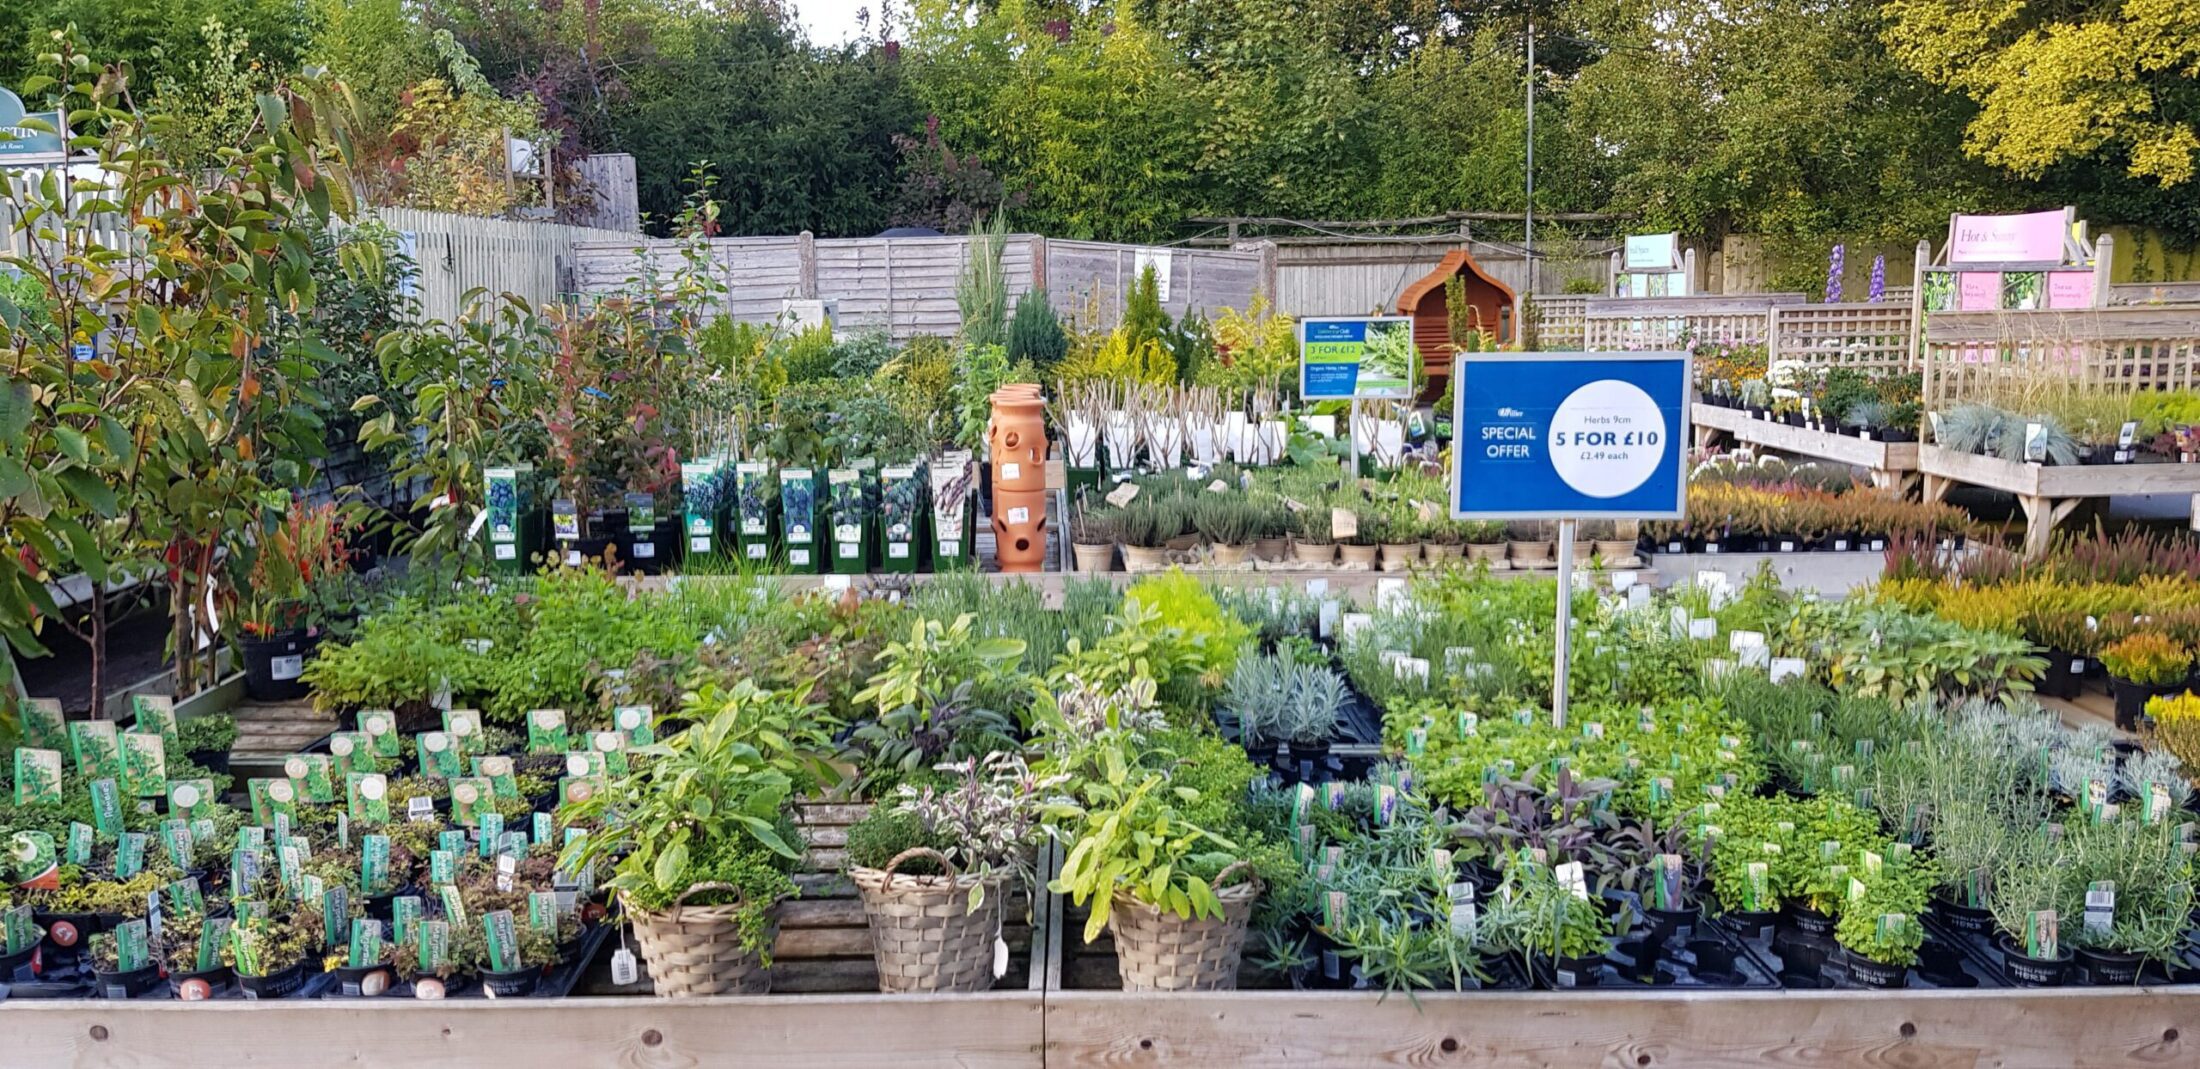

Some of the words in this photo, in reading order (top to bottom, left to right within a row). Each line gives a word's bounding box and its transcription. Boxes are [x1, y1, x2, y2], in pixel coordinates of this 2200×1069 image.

[1961, 229, 1980, 242] Hot
[1318, 345, 1338, 354] FOR
[1340, 345, 1355, 354] £12
[1584, 414, 1610, 425] Herbs
[1613, 414, 1632, 425] 9cm
[1481, 426, 1536, 440] SPECIAL
[1555, 431, 1566, 446] 5
[1574, 431, 1617, 446] FOR
[1623, 431, 1659, 446] £10
[1486, 444, 1530, 458] OFFER
[1580, 451, 1605, 461] £2.49
[1607, 451, 1629, 461] each
[496, 914, 510, 959] Marjoram
[360, 924, 372, 967] Marjoram
[429, 925, 440, 967] Marjoram
[1855, 968, 1887, 985] HERB
[2014, 968, 2048, 983] HERB
